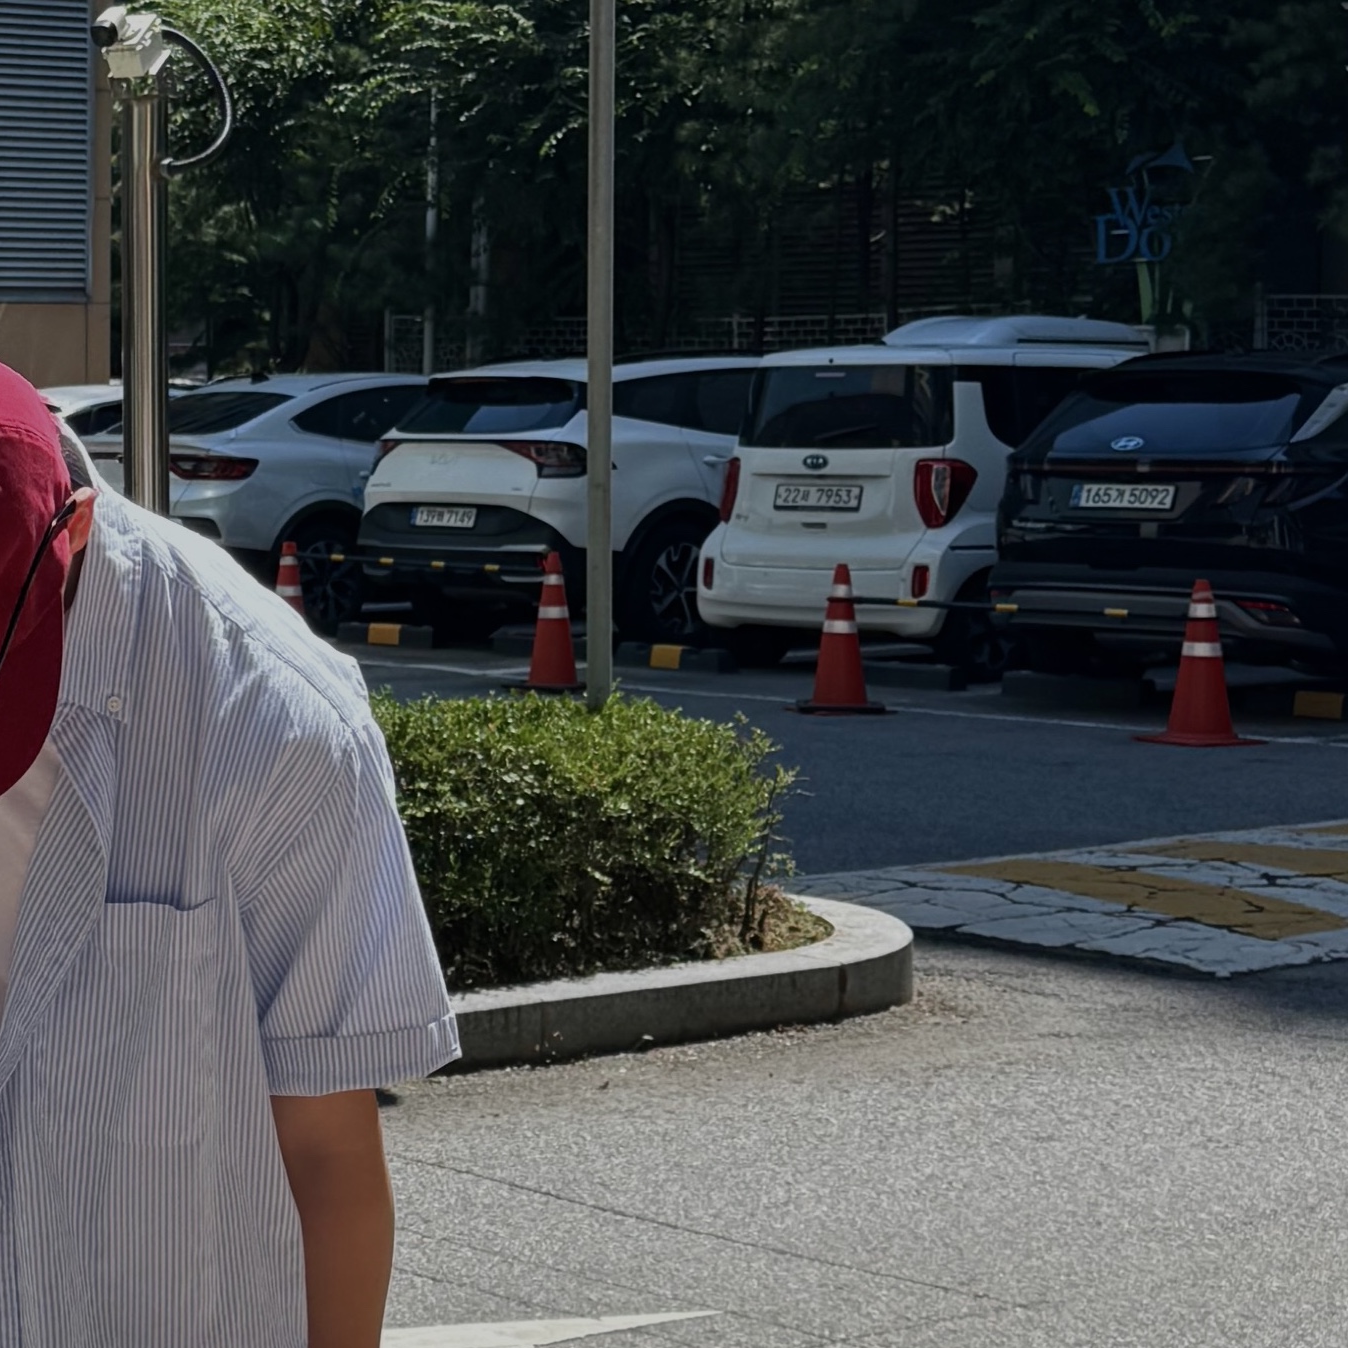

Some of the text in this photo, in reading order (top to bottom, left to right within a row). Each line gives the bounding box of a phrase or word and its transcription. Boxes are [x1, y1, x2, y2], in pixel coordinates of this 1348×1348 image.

[1107, 187, 1181, 227] West
[1093, 214, 1173, 265] Do
[815, 488, 853, 505] 7953
[1127, 487, 1171, 506] 5092
